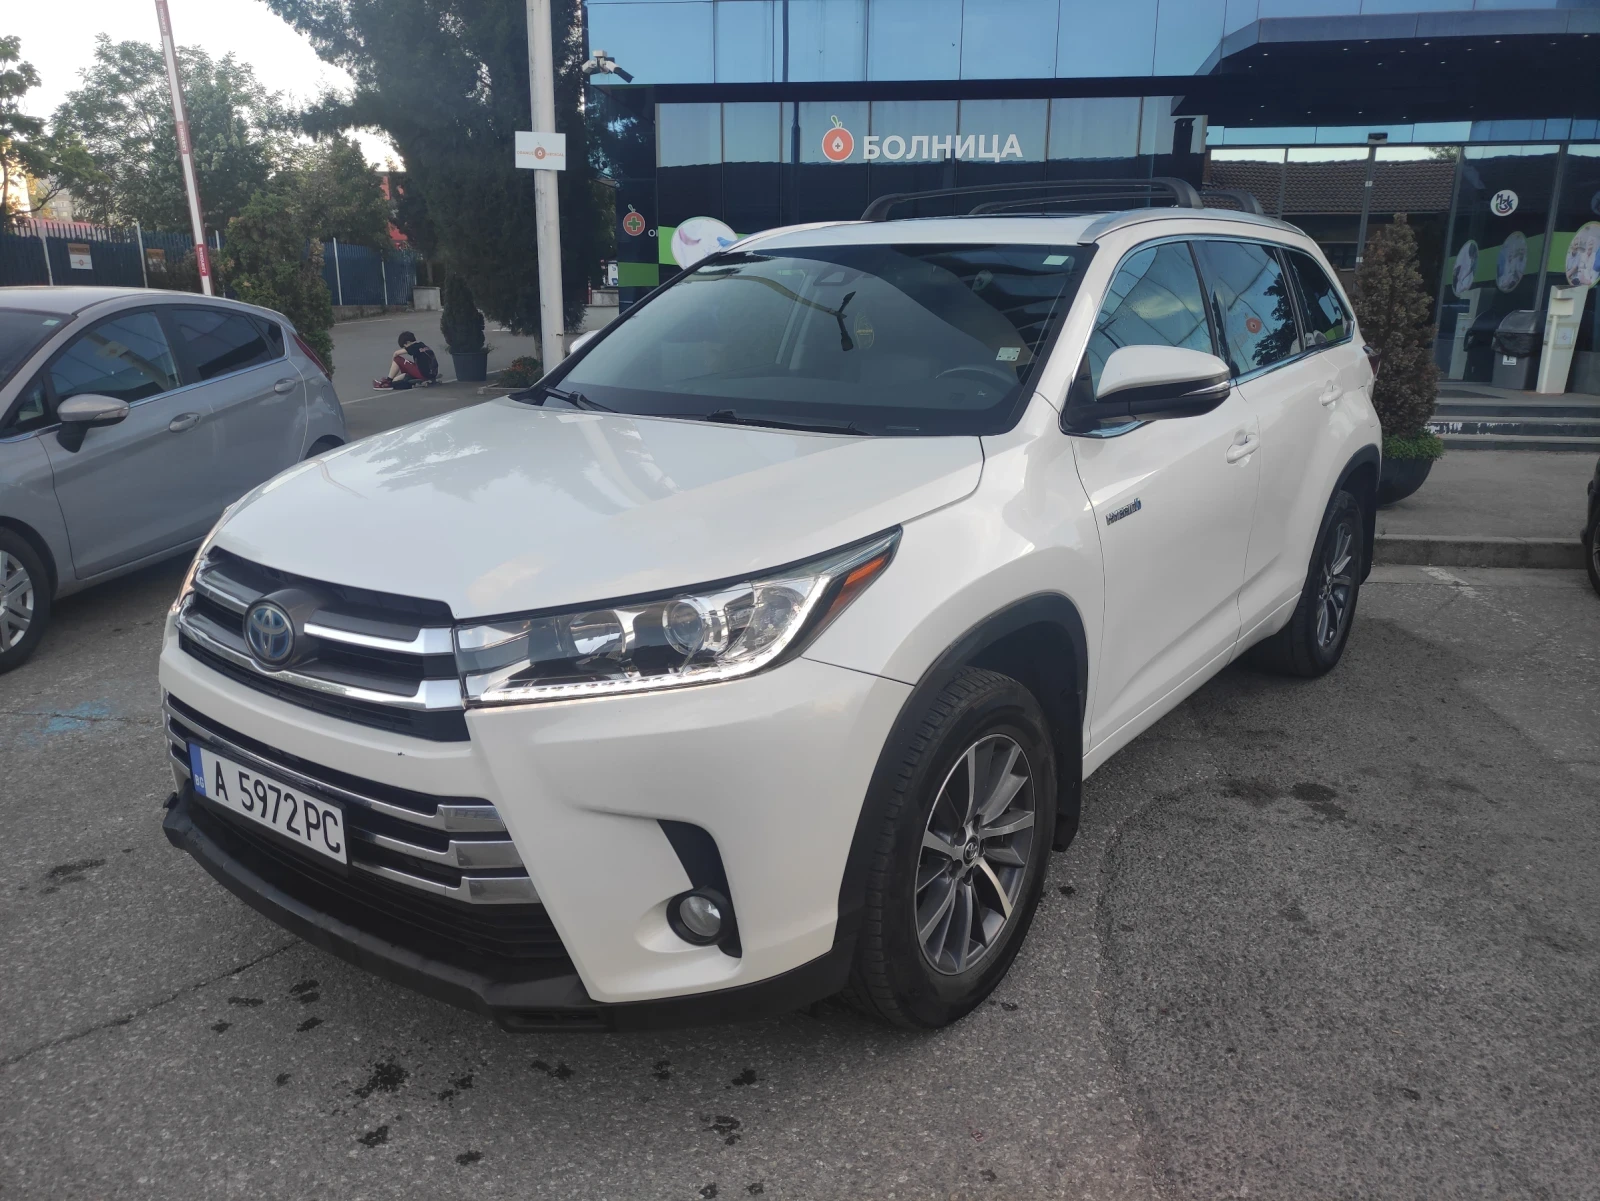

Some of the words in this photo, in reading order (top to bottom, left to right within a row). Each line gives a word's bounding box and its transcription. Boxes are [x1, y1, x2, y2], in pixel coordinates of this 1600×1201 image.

[863, 134, 1023, 162] БОЛНИЦА
[195, 774, 205, 789] BG
[216, 761, 228, 801] A
